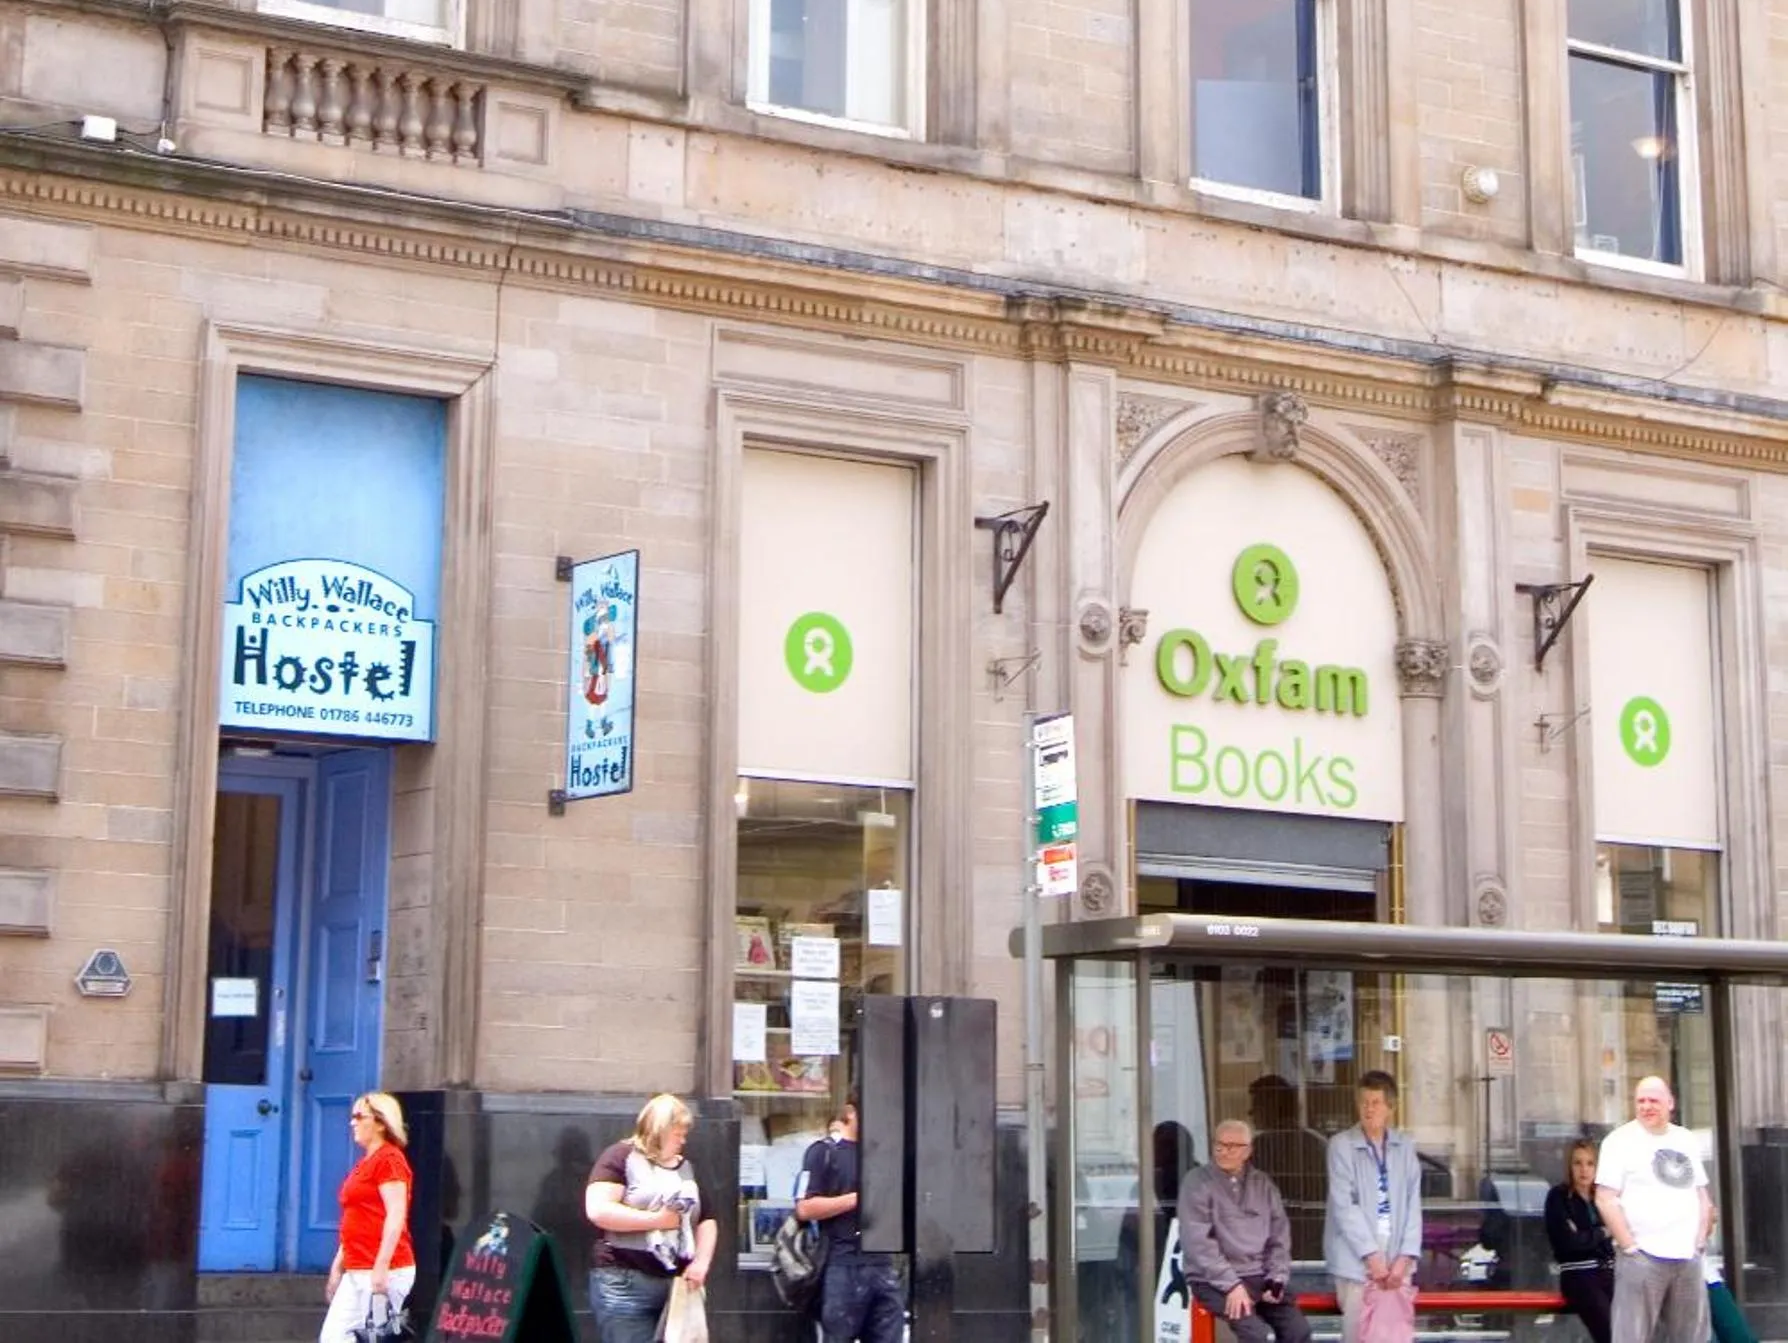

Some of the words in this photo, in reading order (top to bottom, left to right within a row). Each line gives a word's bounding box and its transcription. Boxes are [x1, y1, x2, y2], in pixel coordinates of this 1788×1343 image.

[247, 576, 310, 611] Willy
[322, 575, 409, 623] Wallace
[252, 612, 402, 637] BACKPACKERS
[234, 625, 416, 702] Hostel
[1155, 628, 1368, 717] Oxfam
[234, 701, 315, 718] TELEPHONE
[320, 708, 360, 722] 01786
[365, 711, 413, 727] 446773
[570, 746, 627, 788] Hostel
[1171, 723, 1358, 809] Books
